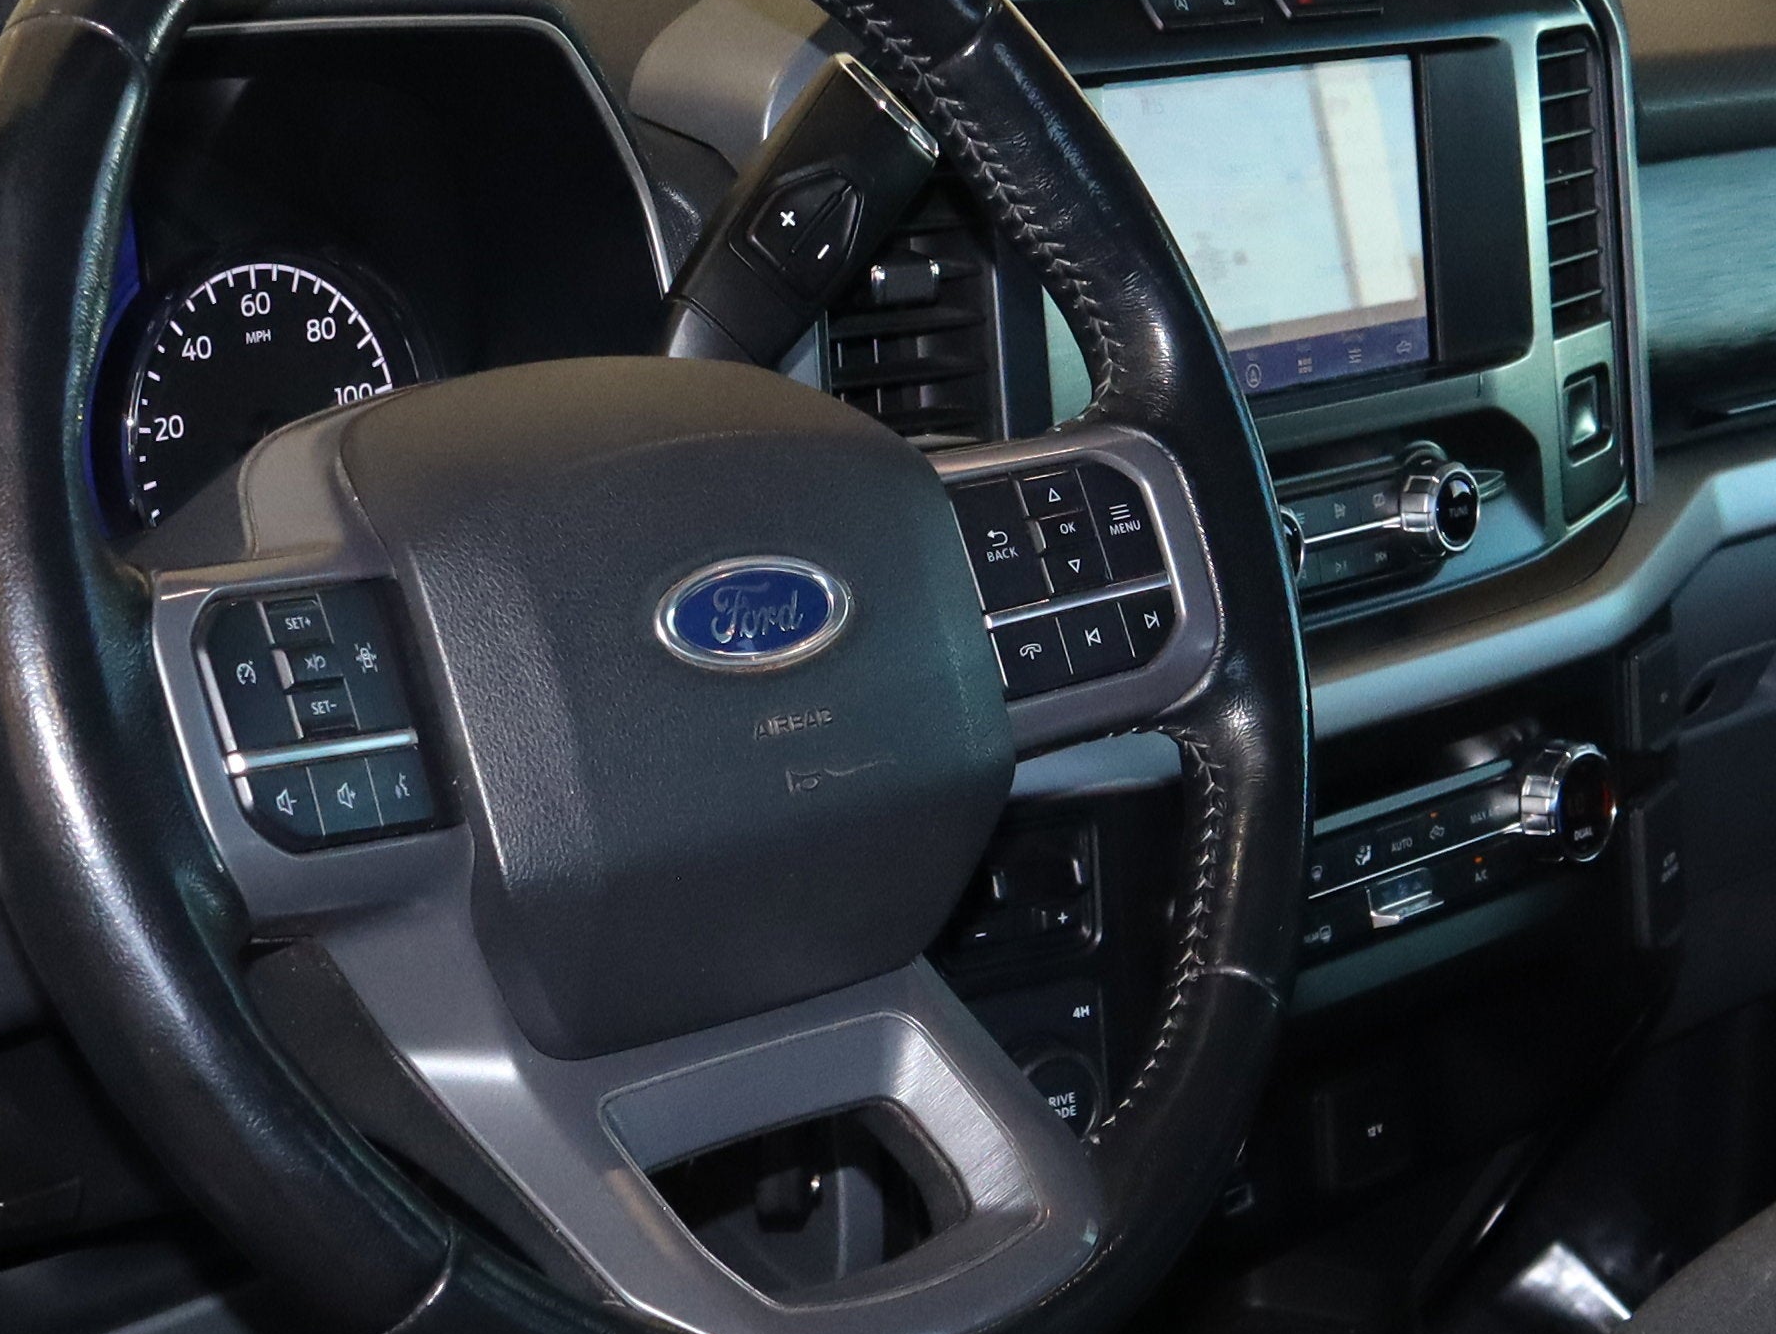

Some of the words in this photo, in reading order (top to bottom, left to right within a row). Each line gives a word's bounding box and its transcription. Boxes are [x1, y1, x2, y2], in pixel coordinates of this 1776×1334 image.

[240, 291, 271, 318] 60
[245, 329, 271, 345] MPH
[306, 317, 336, 343] 80
[181, 335, 212, 361] 40
[334, 382, 373, 406] 100
[154, 415, 184, 442] 20
[1059, 521, 1076, 535] OK
[1109, 519, 1141, 536] MENU
[986, 546, 1019, 563] BACK
[711, 581, 804, 644] Ford
[285, 617, 311, 631] SET+
[754, 707, 833, 741] AIRBAG
[1574, 827, 1593, 841] DUAL
[1391, 837, 1413, 853] AUTO
[1072, 1005, 1090, 1018] 4H
[1048, 1092, 1076, 1107] RIVE
